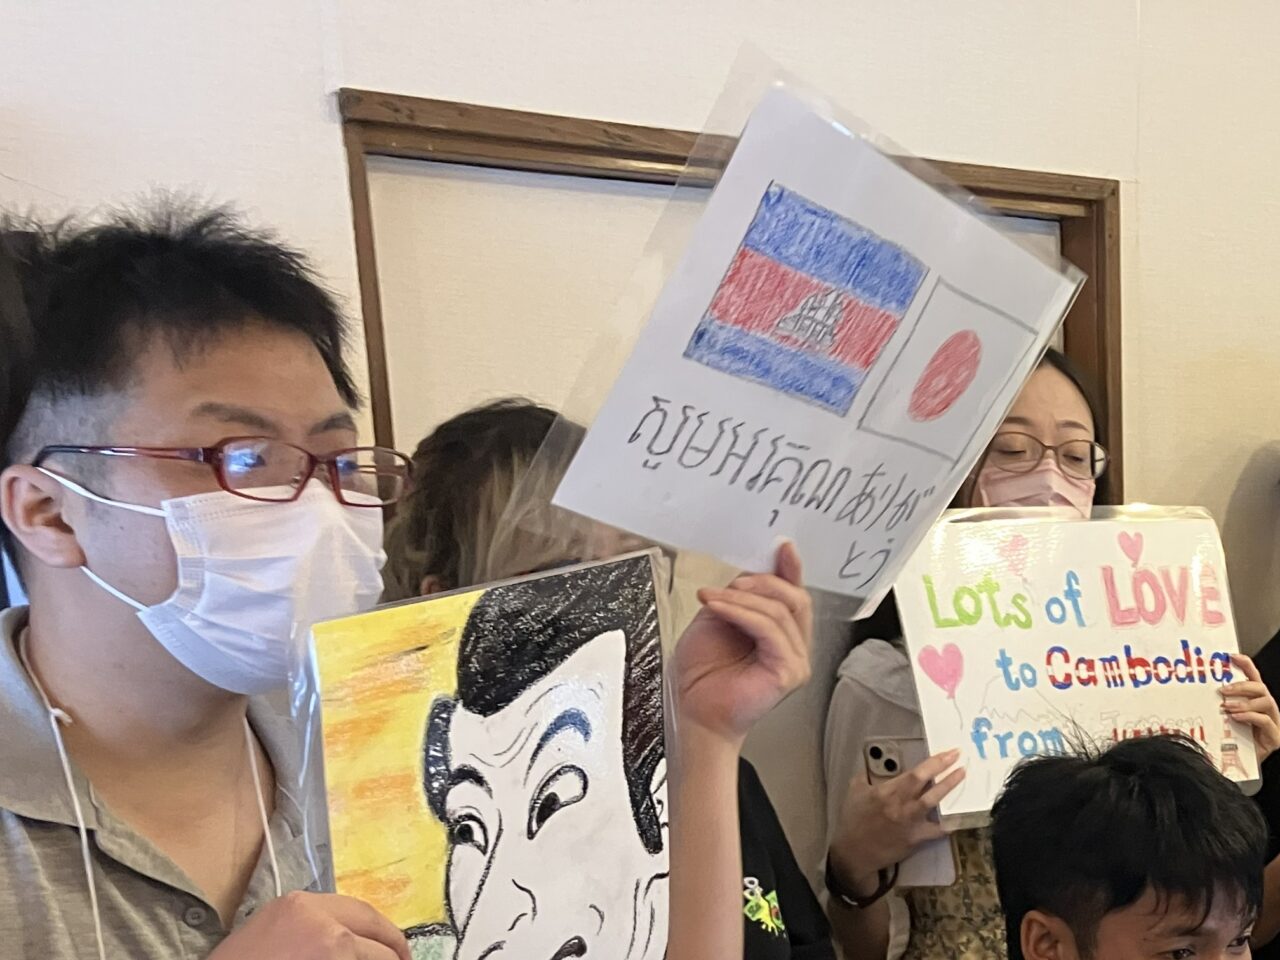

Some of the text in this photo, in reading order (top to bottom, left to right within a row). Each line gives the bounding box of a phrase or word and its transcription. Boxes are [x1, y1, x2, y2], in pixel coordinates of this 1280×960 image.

[1045, 571, 1086, 627] of
[1100, 564, 1227, 629] LOVE
[996, 640, 1234, 691] to Cambodia
[970, 717, 1067, 759] from
